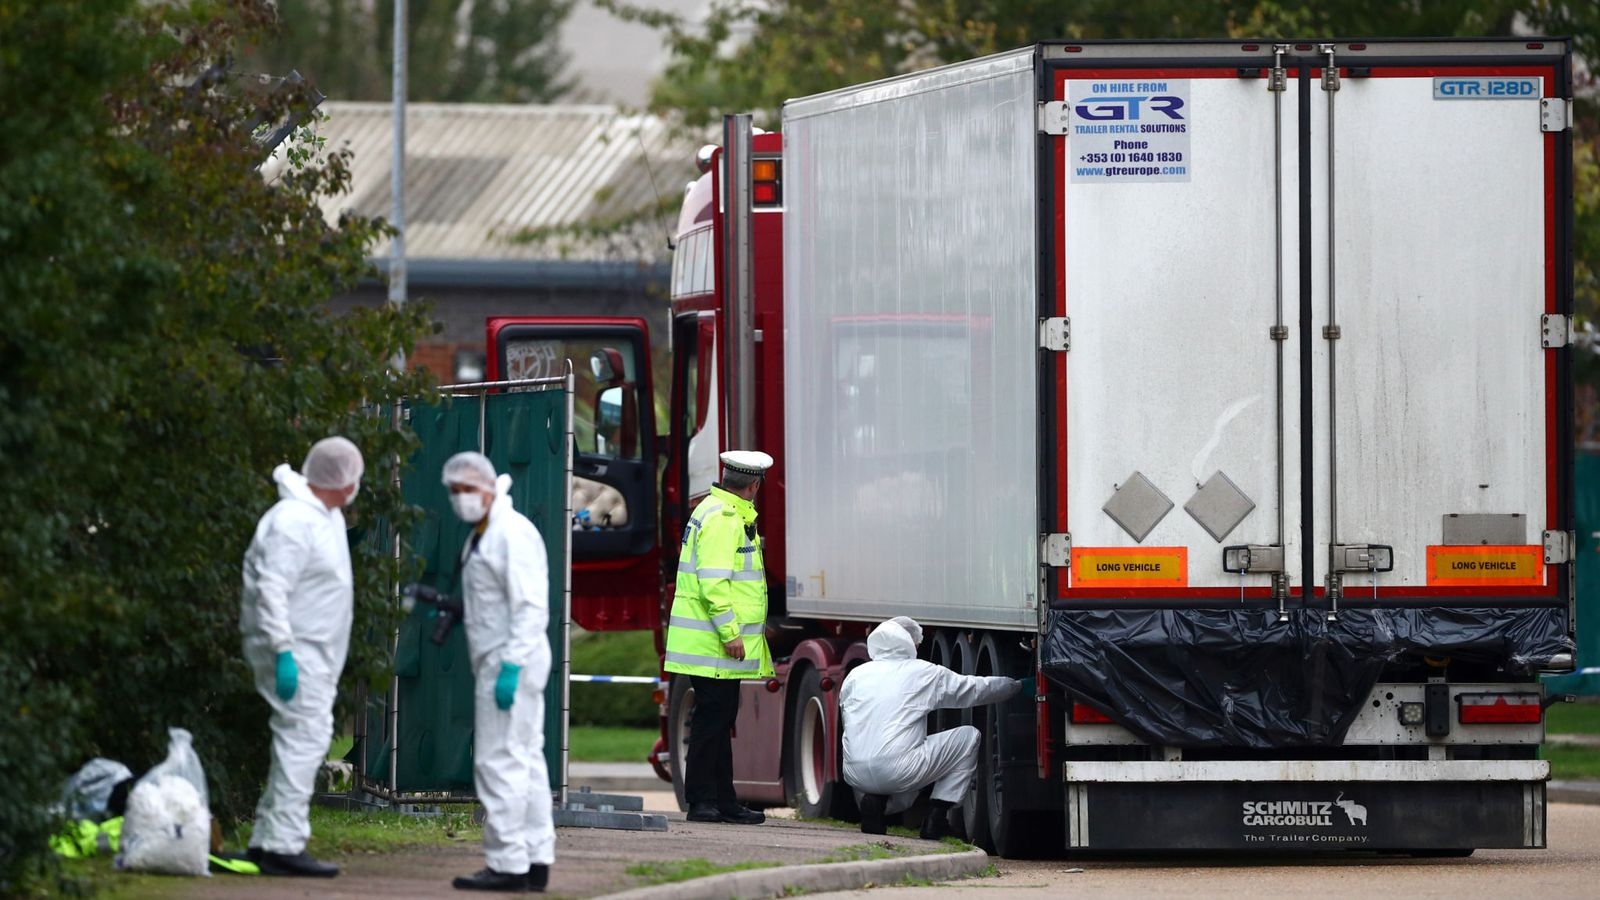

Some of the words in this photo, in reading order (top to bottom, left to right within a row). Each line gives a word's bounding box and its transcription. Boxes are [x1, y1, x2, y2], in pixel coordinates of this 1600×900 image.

[1092, 83, 1107, 93] ON
[1110, 83, 1134, 92] HIRE
[1137, 83, 1167, 92] FROM
[1075, 96, 1185, 120] GTR
[1075, 125, 1108, 134] TRAILER
[1110, 125, 1139, 133] RENTAL
[1141, 124, 1186, 133] SOLUTIONS
[1114, 140, 1148, 150] Phone
[1080, 153, 1108, 163] +353
[1128, 153, 1153, 162] 1640
[1157, 152, 1182, 162] 1830
[1077, 166, 1186, 176] www.gtreurope.com
[1452, 562, 1476, 570] LONG
[1479, 562, 1516, 570] VEHICLE
[1243, 801, 1332, 815] SCHMITZ
[1243, 816, 1332, 825] CARGOBULL
